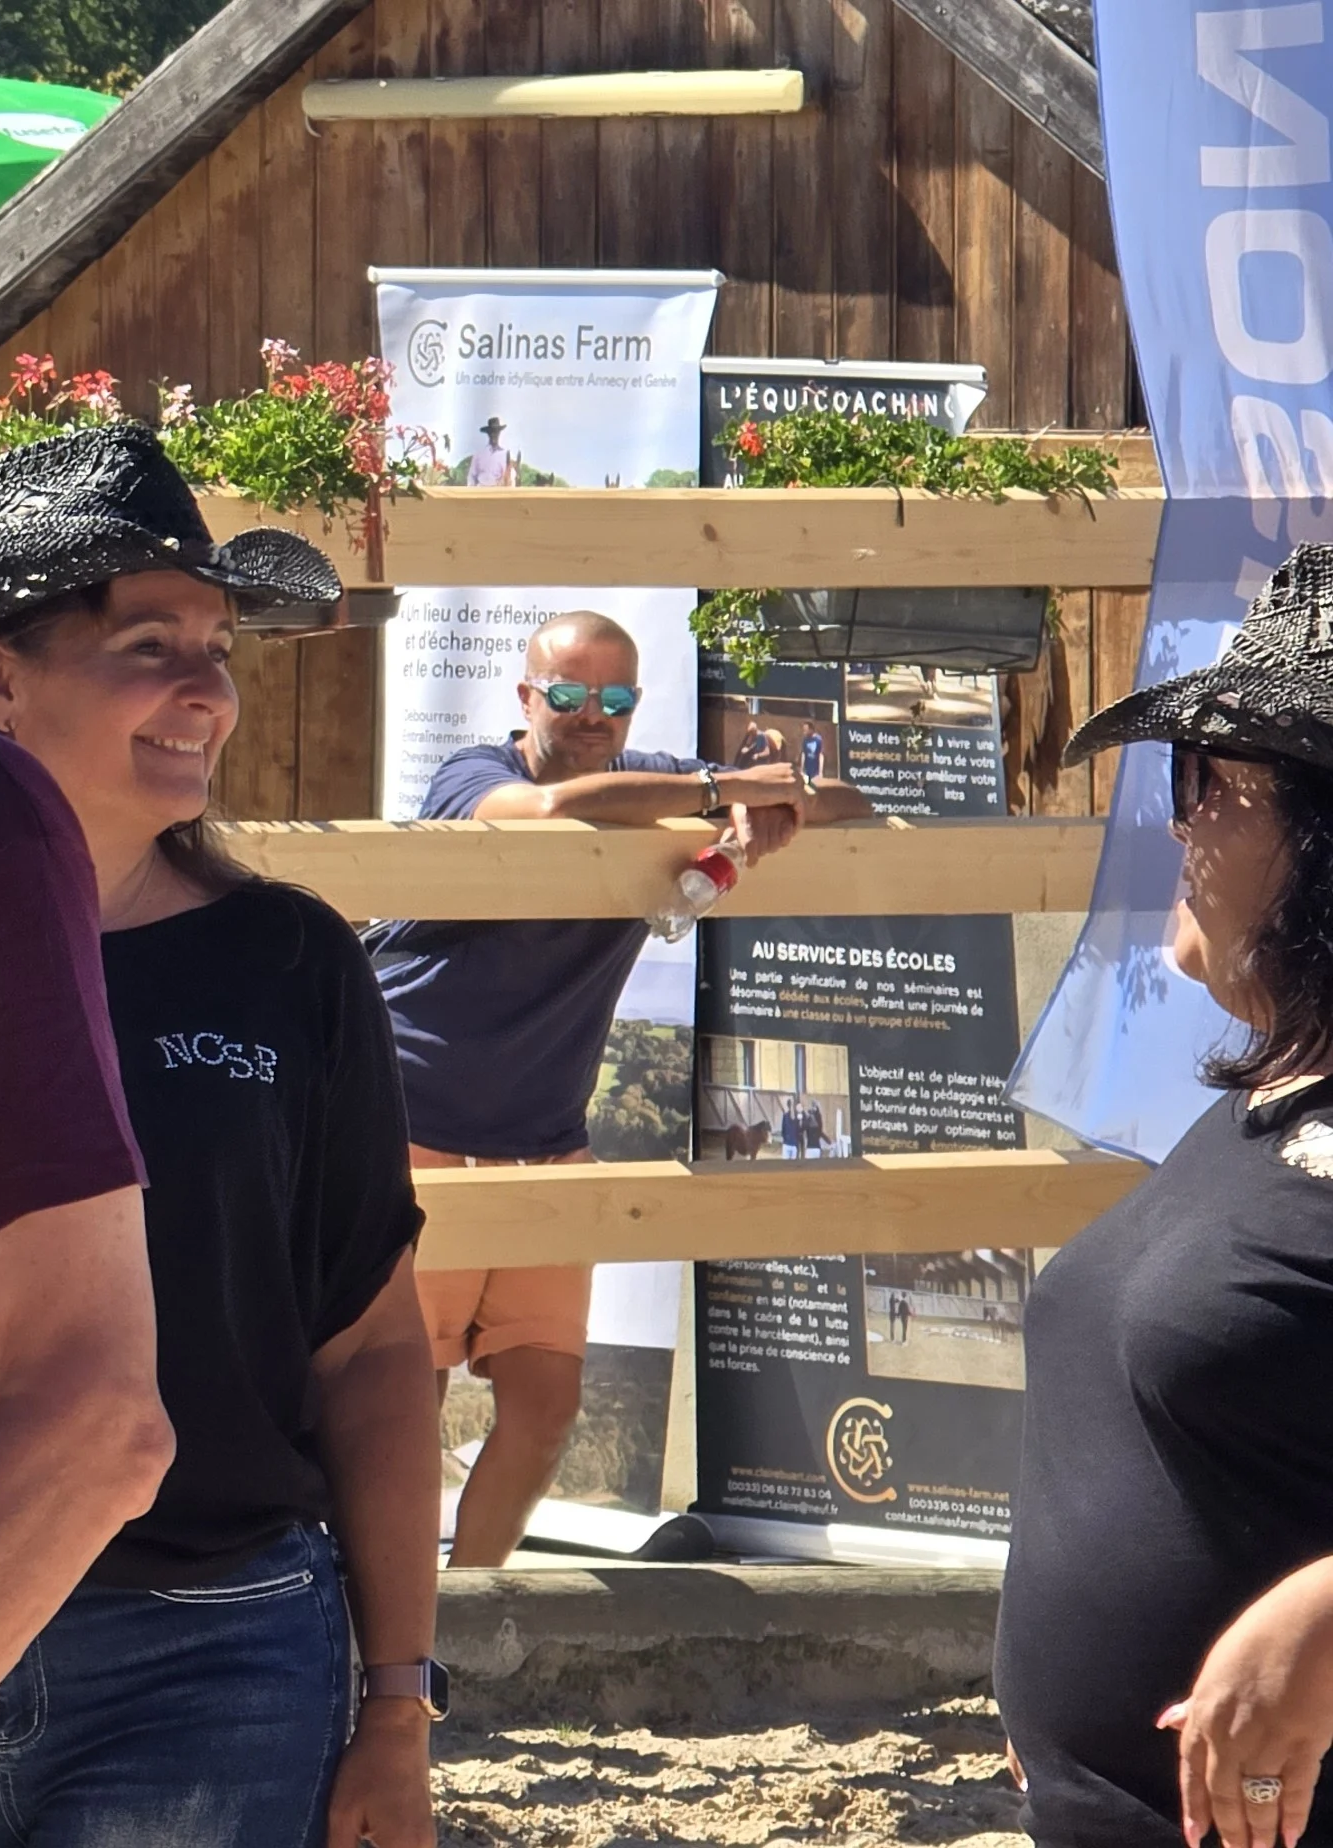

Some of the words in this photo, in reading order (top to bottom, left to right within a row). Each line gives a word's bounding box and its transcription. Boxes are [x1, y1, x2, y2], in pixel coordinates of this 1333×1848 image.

[458, 322, 565, 360] Salinas
[576, 324, 652, 361] Farm
[455, 371, 468, 385] Un
[472, 369, 506, 386] cadre
[556, 374, 584, 387] entre
[587, 372, 629, 390] Annecy
[631, 374, 643, 388] et
[423, 602, 451, 622] lieu
[457, 603, 481, 623] de
[405, 634, 416, 649] et
[419, 631, 518, 656] d'échanges
[403, 662, 413, 677] et
[416, 661, 428, 677] le
[478, 734, 504, 747] pour
[849, 729, 872, 744] Vous
[877, 732, 900, 745] êtes
[947, 736, 971, 750] vivre
[976, 739, 995, 751] une
[954, 753, 967, 766] de
[970, 755, 996, 769] votre
[849, 766, 894, 779] quotidien
[971, 774, 996, 787] votre
[986, 791, 998, 804] et
[752, 940, 774, 960] AU
[777, 942, 846, 966] SERVICE
[849, 947, 883, 968] DES
[886, 946, 956, 973] ÉCOLES
[729, 967, 747, 981] Une
[755, 971, 783, 984] partie
[790, 972, 847, 989] significative
[855, 977, 868, 990] de
[876, 981, 895, 993] nos
[904, 981, 960, 998] séminaires
[966, 987, 983, 1000] est
[783, 1008, 799, 1019] une
[801, 1009, 831, 1022] classe
[907, 1001, 928, 1012] une
[931, 1000, 968, 1015] journée
[970, 1003, 983, 1017] de
[858, 1064, 905, 1081] L'objectif
[908, 1070, 925, 1082] est
[929, 1069, 943, 1083] de
[947, 1071, 978, 1086] placer
[859, 1085, 872, 1095] au
[904, 1085, 918, 1099] de
[920, 1086, 930, 1099] la
[933, 1087, 984, 1107] pédagogie
[874, 1100, 907, 1115] fournir
[909, 1103, 927, 1117] des
[930, 1105, 959, 1119] outils
[961, 1109, 1002, 1123] concrets
[1004, 1112, 1015, 1124] et
[861, 1118, 909, 1133] pratiques
[914, 1122, 938, 1135] pour
[945, 1124, 991, 1138] optimiser
[997, 1130, 1016, 1141] son
[754, 1312, 782, 1324] cadre
[789, 1313, 802, 1326] de
[739, 1343, 764, 1356] prise
[765, 1345, 778, 1357] de
[780, 1348, 836, 1364] conscience
[837, 1352, 851, 1365] de
